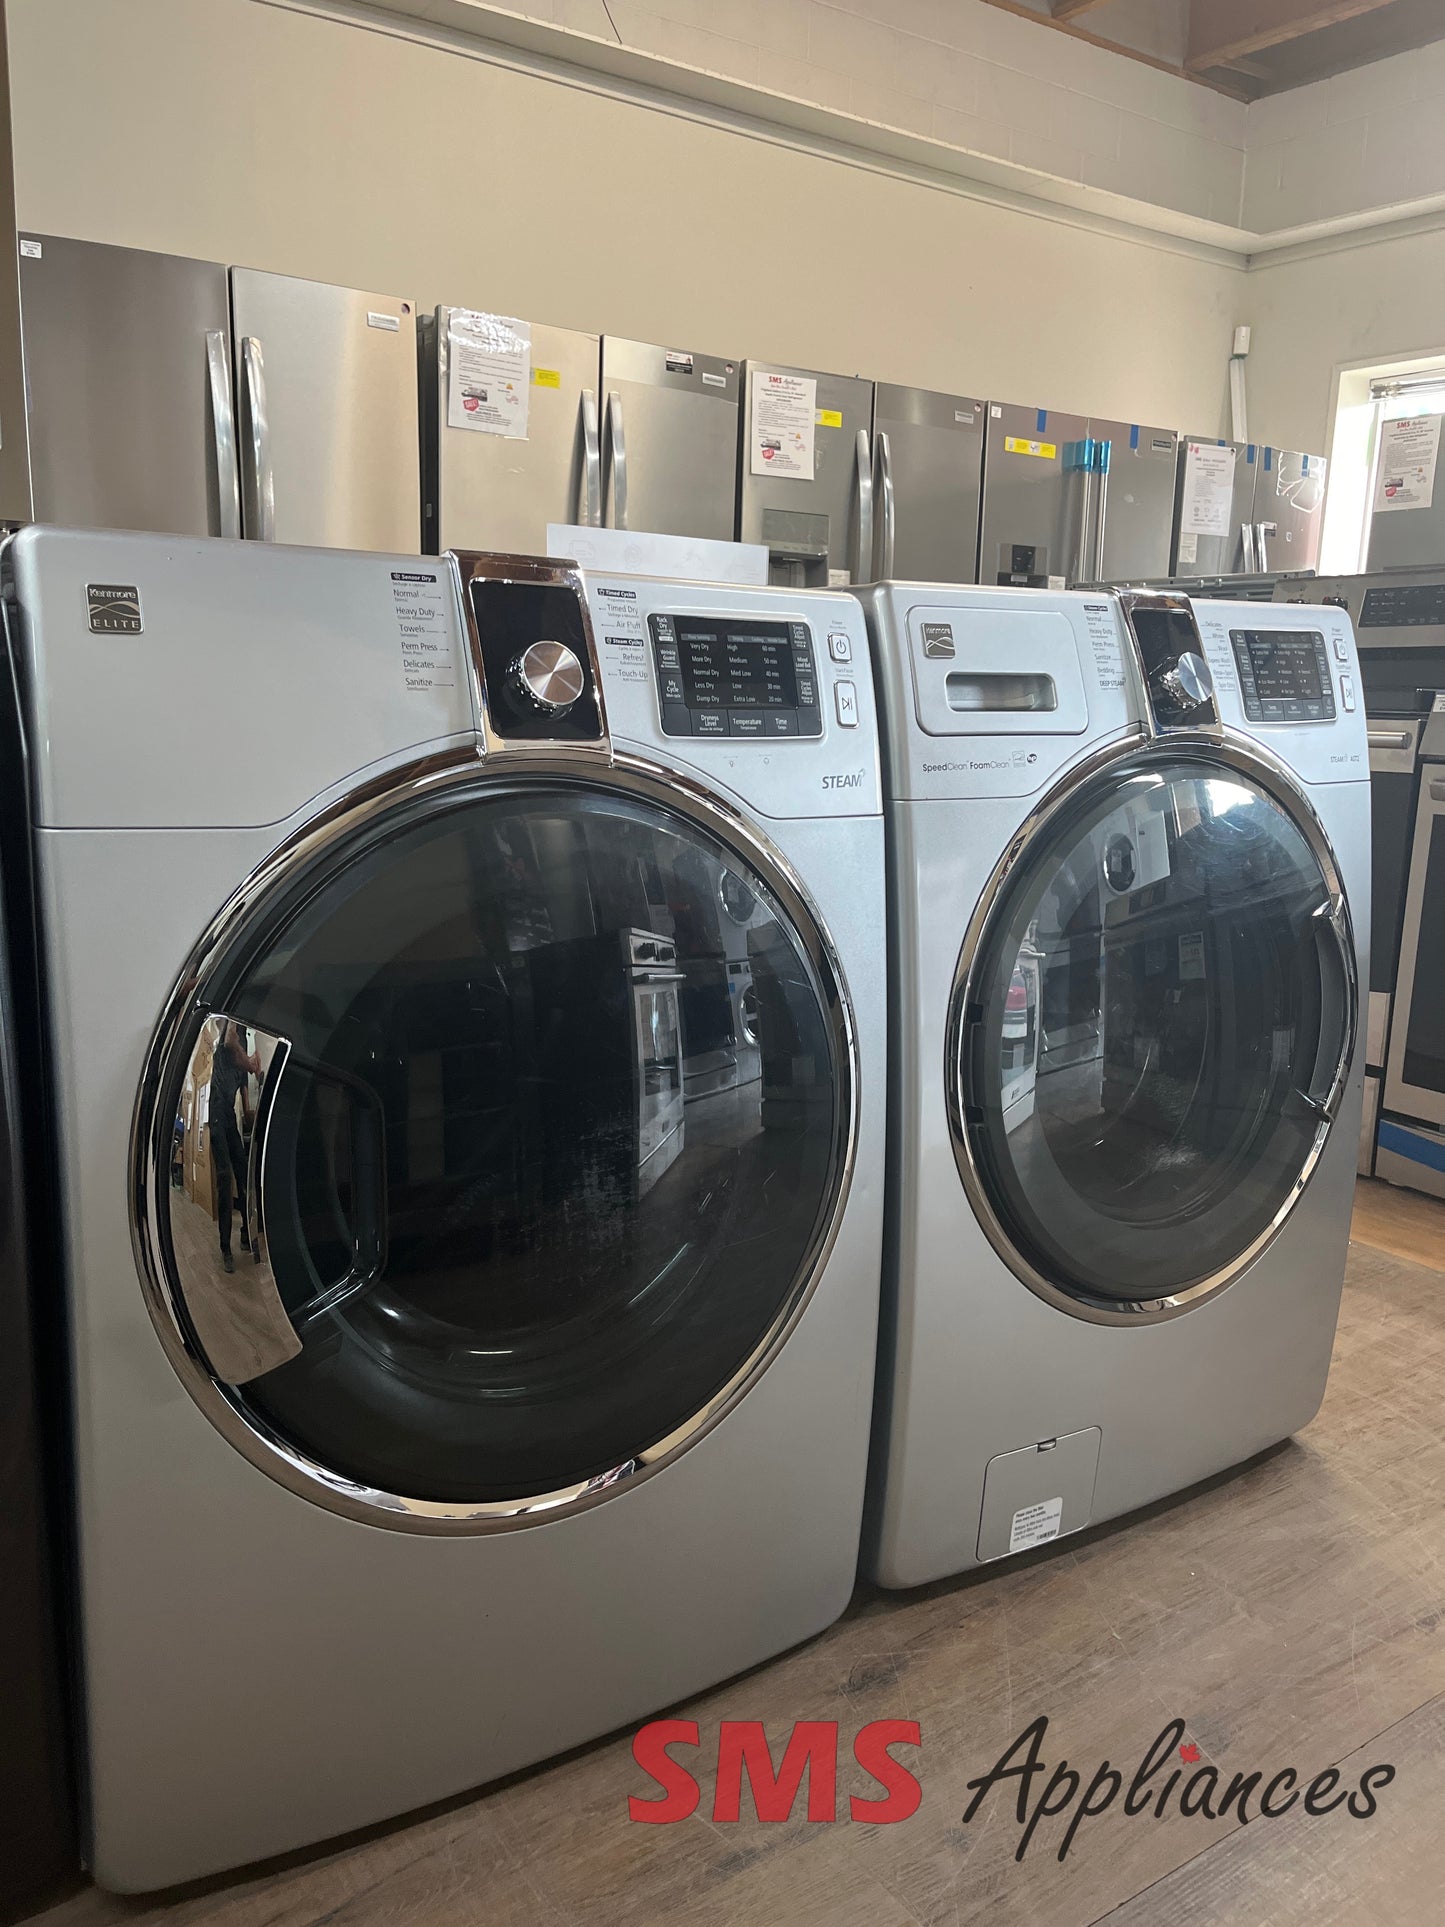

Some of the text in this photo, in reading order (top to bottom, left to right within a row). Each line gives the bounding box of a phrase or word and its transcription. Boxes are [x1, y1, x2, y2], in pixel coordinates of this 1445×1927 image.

[89, 588, 136, 598] Kenmore
[393, 589, 419, 598] Normal
[396, 606, 418, 616] Heavy
[419, 608, 435, 618] Duty
[607, 604, 638, 615] Timed Dry
[93, 619, 139, 628] ELITE
[400, 624, 425, 633] Towels
[402, 642, 438, 651] Perm Press
[404, 660, 435, 668] Delicates
[922, 760, 1009, 773] SpeedClean FoamClean
[822, 774, 862, 789] STEAM
